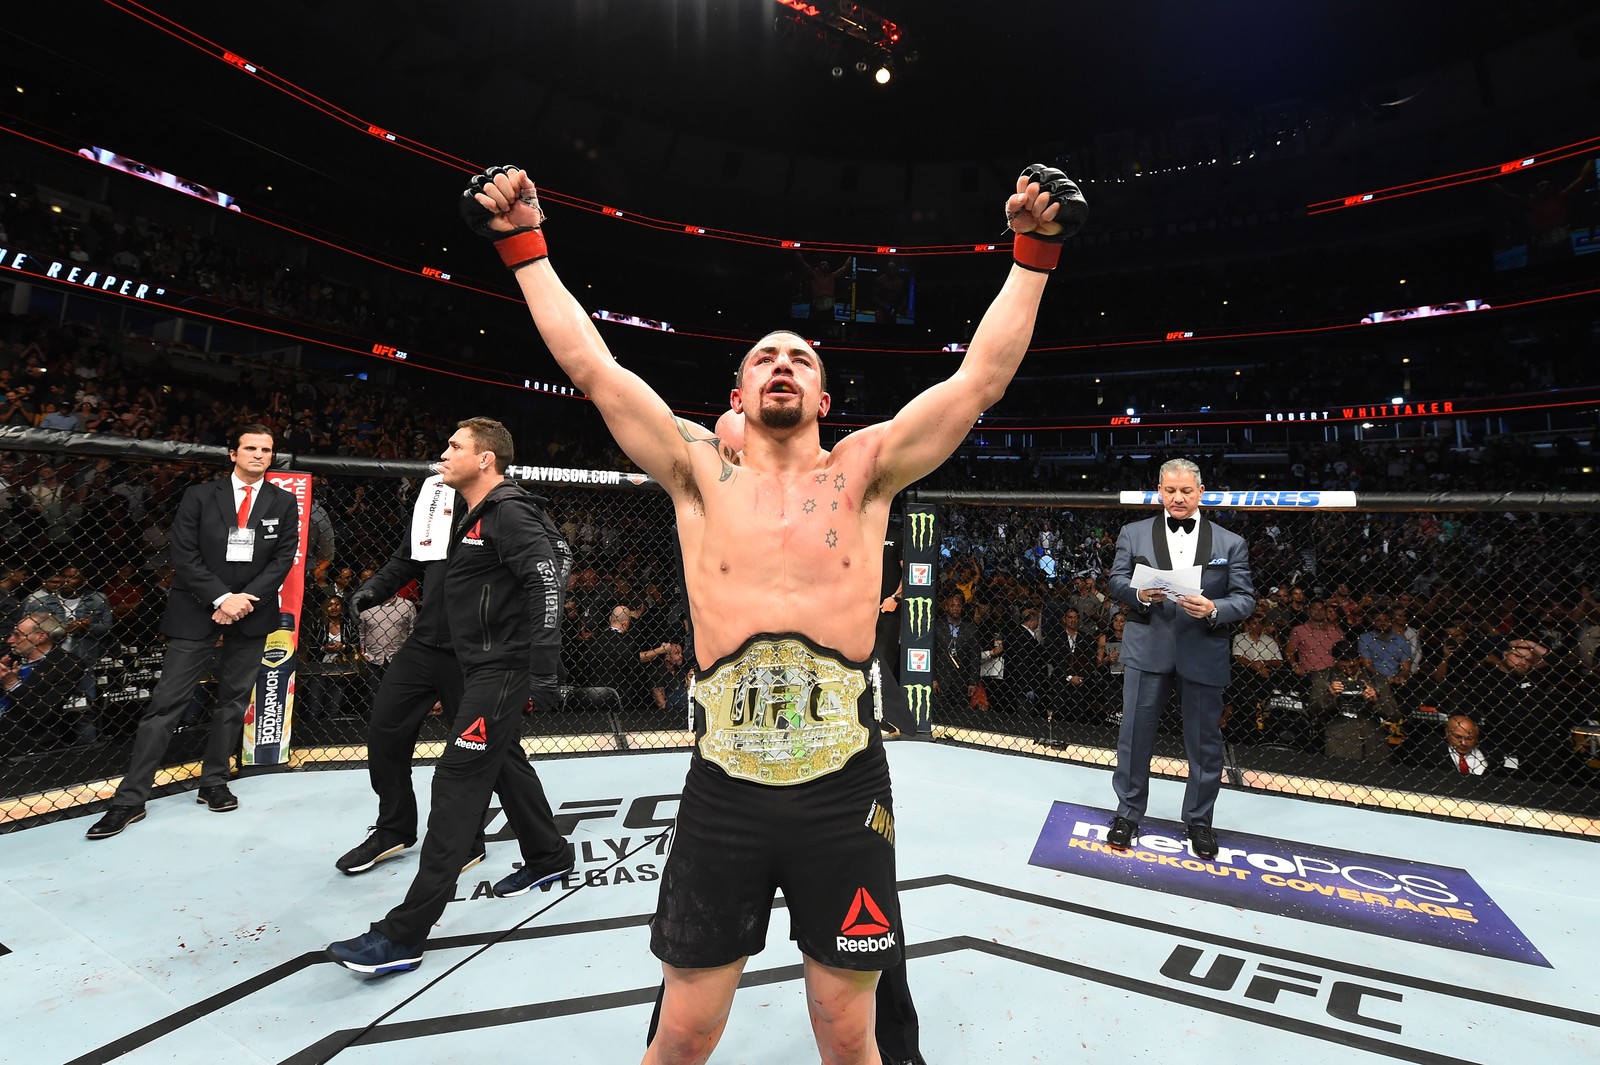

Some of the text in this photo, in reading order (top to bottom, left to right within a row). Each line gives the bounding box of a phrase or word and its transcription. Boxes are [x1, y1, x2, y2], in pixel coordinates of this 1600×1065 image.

[223, 52, 246, 68] UFC
[369, 125, 387, 138] UFC
[1501, 160, 1523, 172] UFC
[1345, 195, 1363, 205] UFC
[422, 267, 442, 279] UFC
[1166, 332, 1184, 340] UFC
[372, 343, 397, 358] UFC
[524, 379, 575, 396] ROBERT
[1265, 401, 1454, 422] ROBERT WHITTAKER
[1110, 416, 1131, 425] UFC
[1142, 491, 1321, 507] TO TIRES
[262, 669, 280, 745] BODYARMOR
[454, 737, 487, 751] Reebok
[644, 833, 669, 856] 7
[1068, 838, 1252, 881] KNOCKOUT
[452, 880, 495, 902] LA
[836, 932, 896, 953] Reebok
[1159, 943, 1404, 1036] UFC
